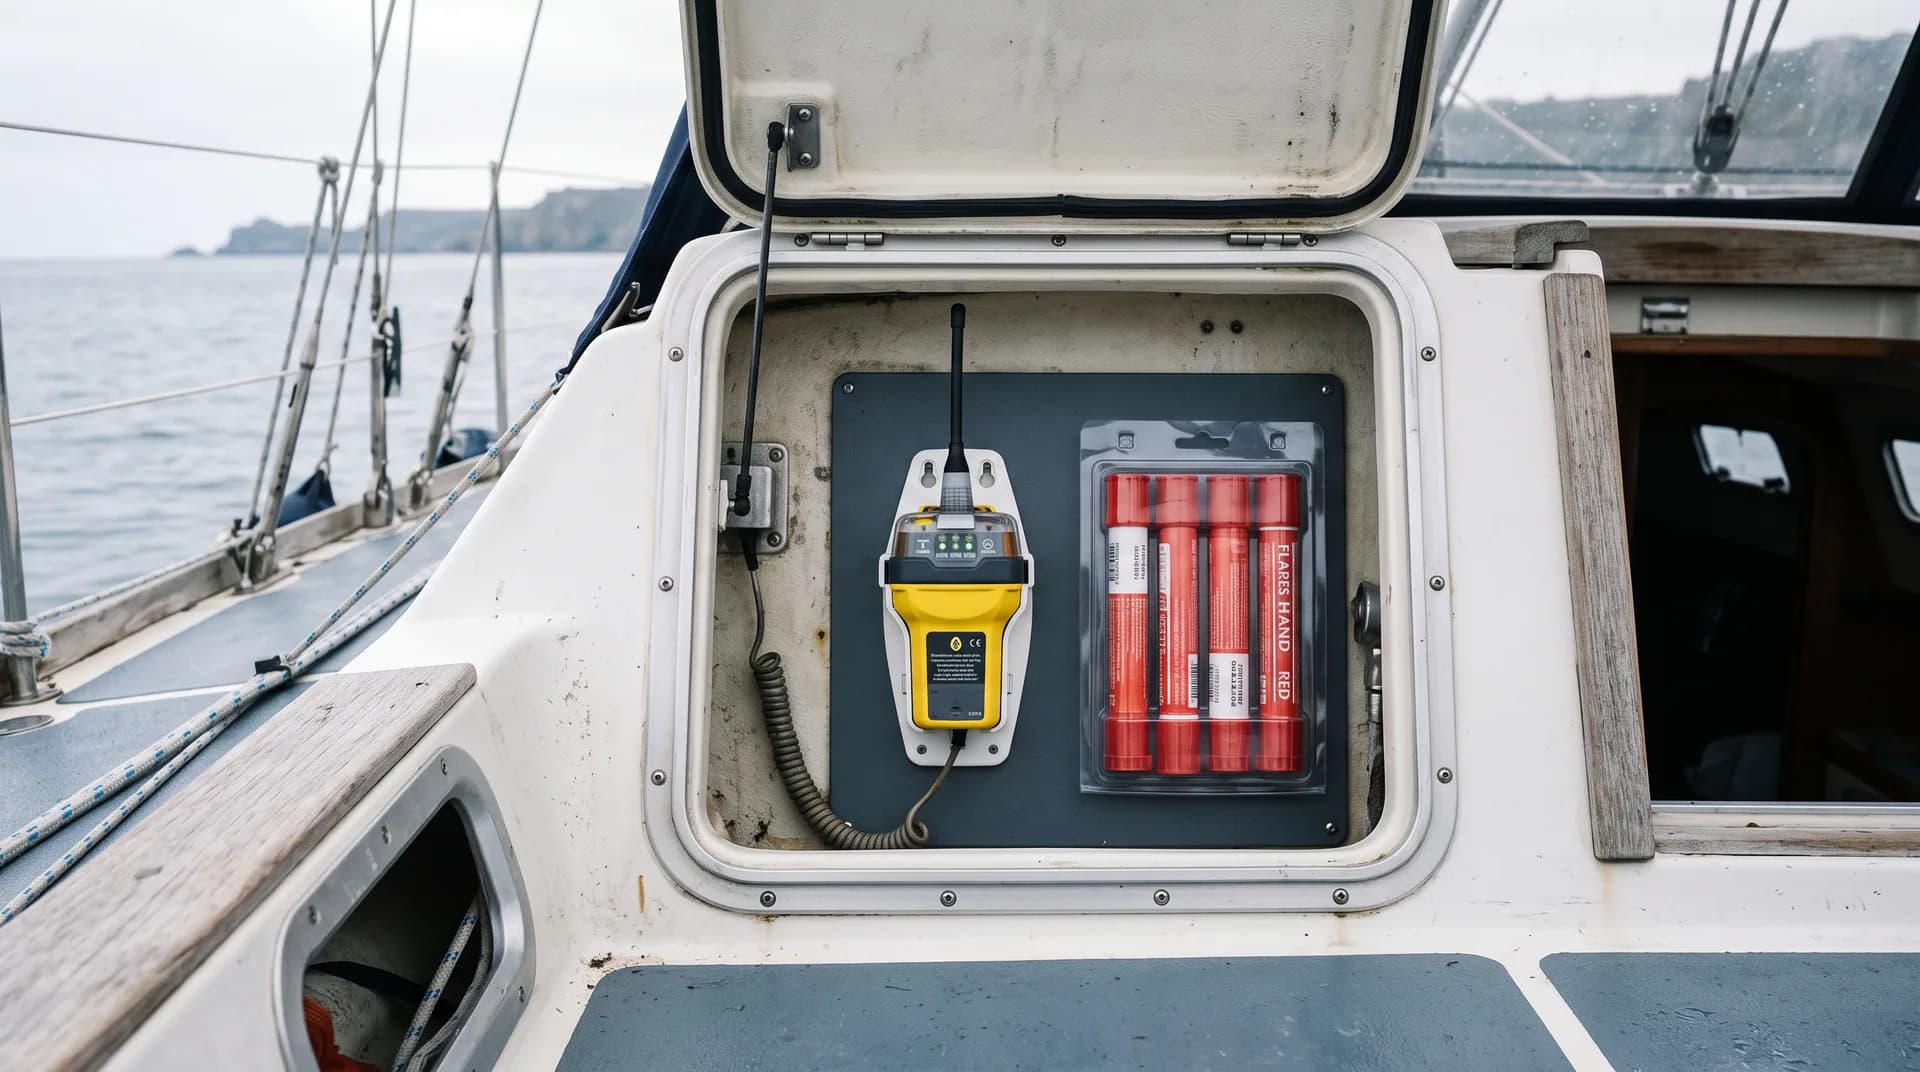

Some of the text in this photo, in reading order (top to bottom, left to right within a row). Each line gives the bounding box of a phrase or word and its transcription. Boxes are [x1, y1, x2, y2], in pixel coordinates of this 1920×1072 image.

[969, 638, 981, 648] CE
[1278, 544, 1290, 700] FLARES HAND RED
